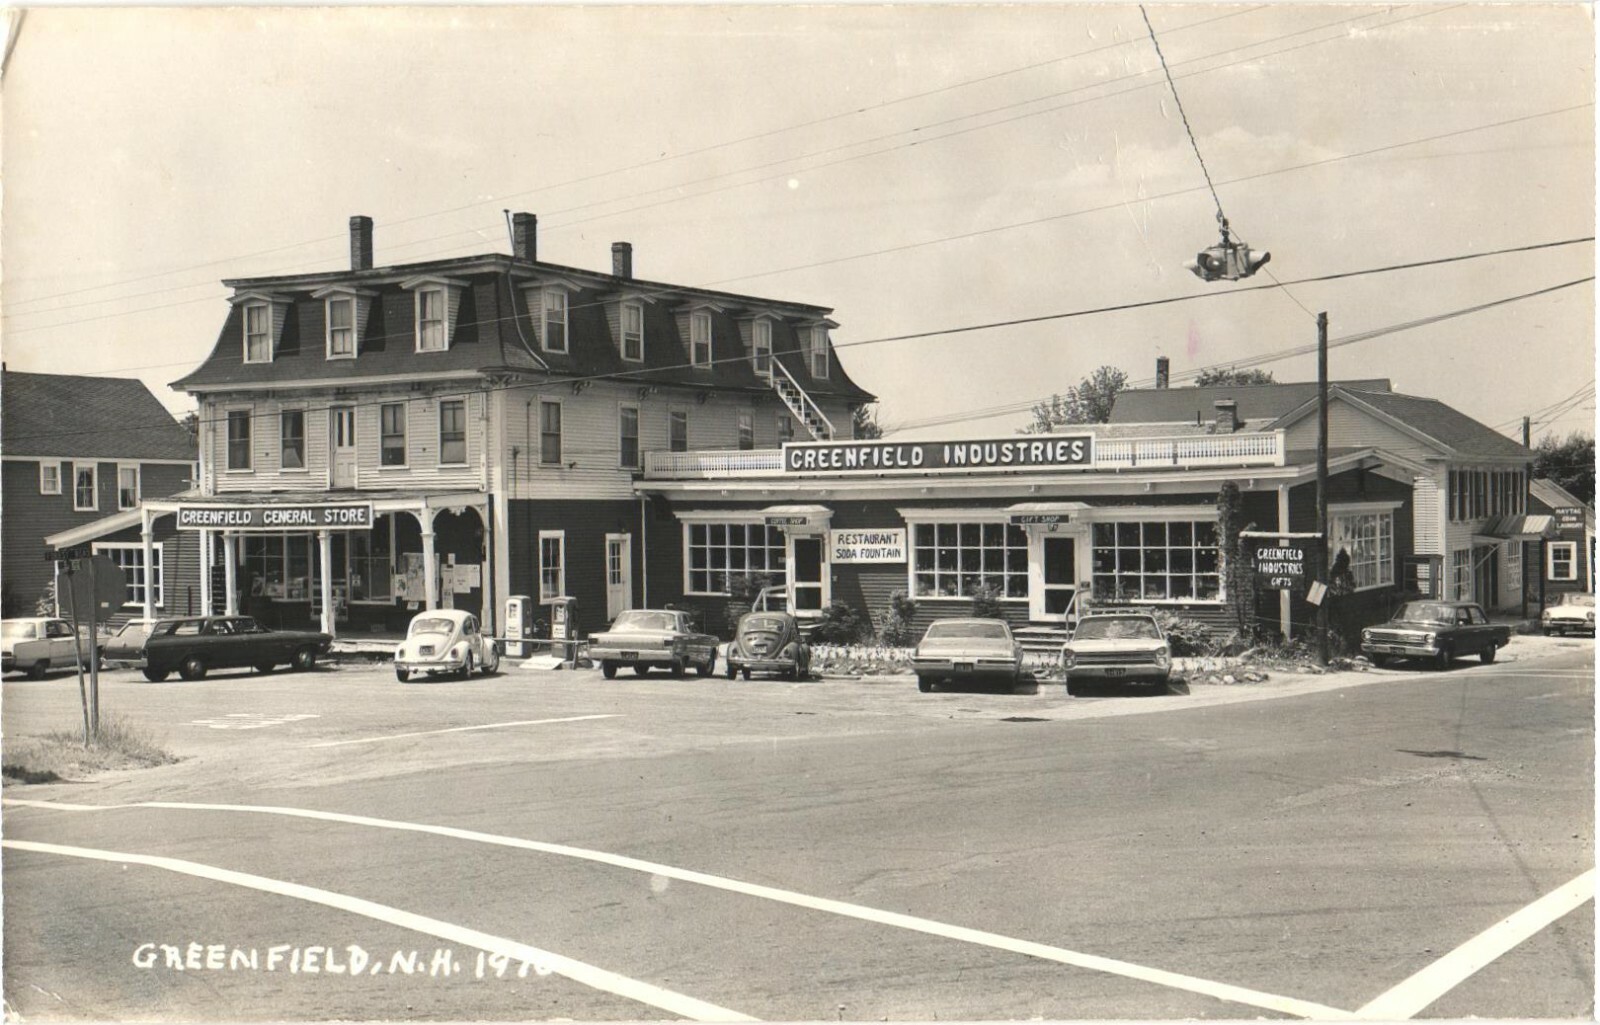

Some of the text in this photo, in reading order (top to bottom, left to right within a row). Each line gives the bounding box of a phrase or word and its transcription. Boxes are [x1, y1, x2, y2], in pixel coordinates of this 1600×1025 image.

[790, 440, 1085, 469] GREENFIELD INDUSTRIES
[181, 508, 365, 524] GREENFIELD GENERAL STORE
[837, 533, 899, 545] RESTAURANT
[836, 547, 901, 559] SODA FOUNTAIN
[1257, 548, 1303, 560] GREENFIELD
[1258, 562, 1303, 575] INDUSTRIES
[1271, 577, 1292, 587] GIFTS
